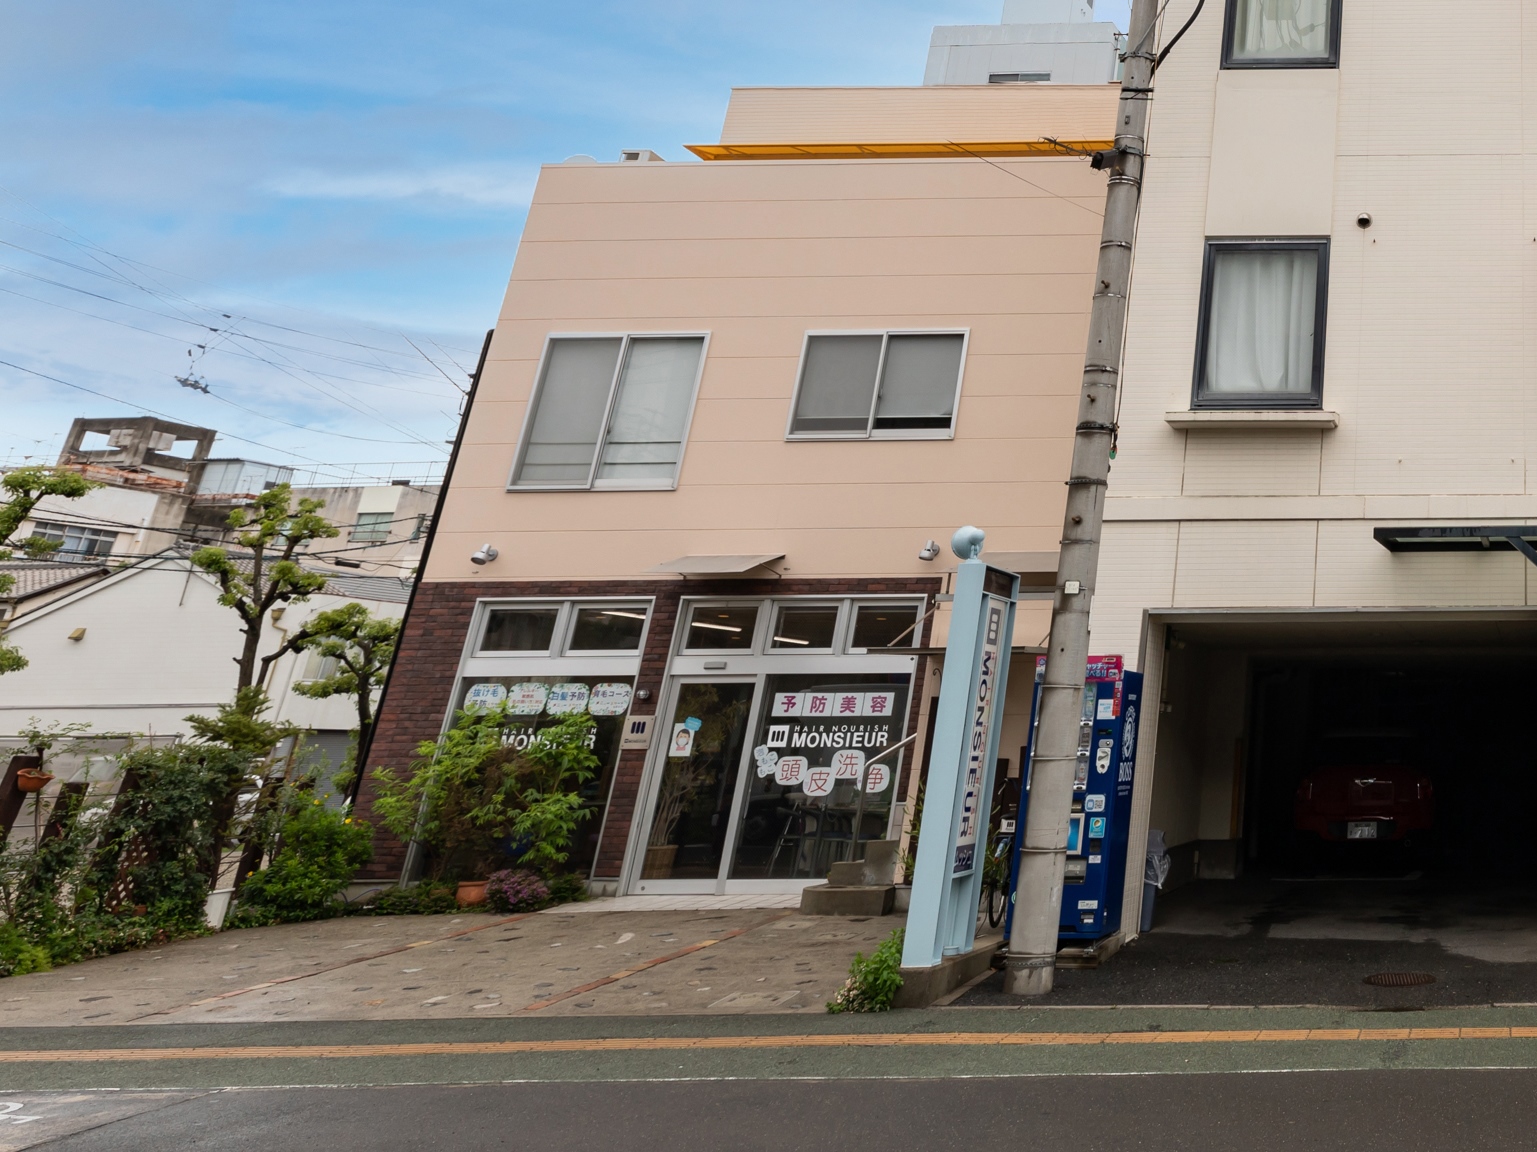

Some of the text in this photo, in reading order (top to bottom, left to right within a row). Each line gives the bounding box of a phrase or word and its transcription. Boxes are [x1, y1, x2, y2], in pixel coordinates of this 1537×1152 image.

[985, 651, 997, 706] HAIR
[472, 688, 499, 698] 抜け毛
[550, 691, 586, 701] 白髪予防
[593, 689, 630, 698] 育毛コース
[781, 695, 888, 714] 予防美容
[502, 727, 534, 735] HAIR
[791, 732, 889, 748] MONSIEUR
[958, 650, 992, 838] MONSIEUR
[1118, 761, 1133, 782] BOSS
